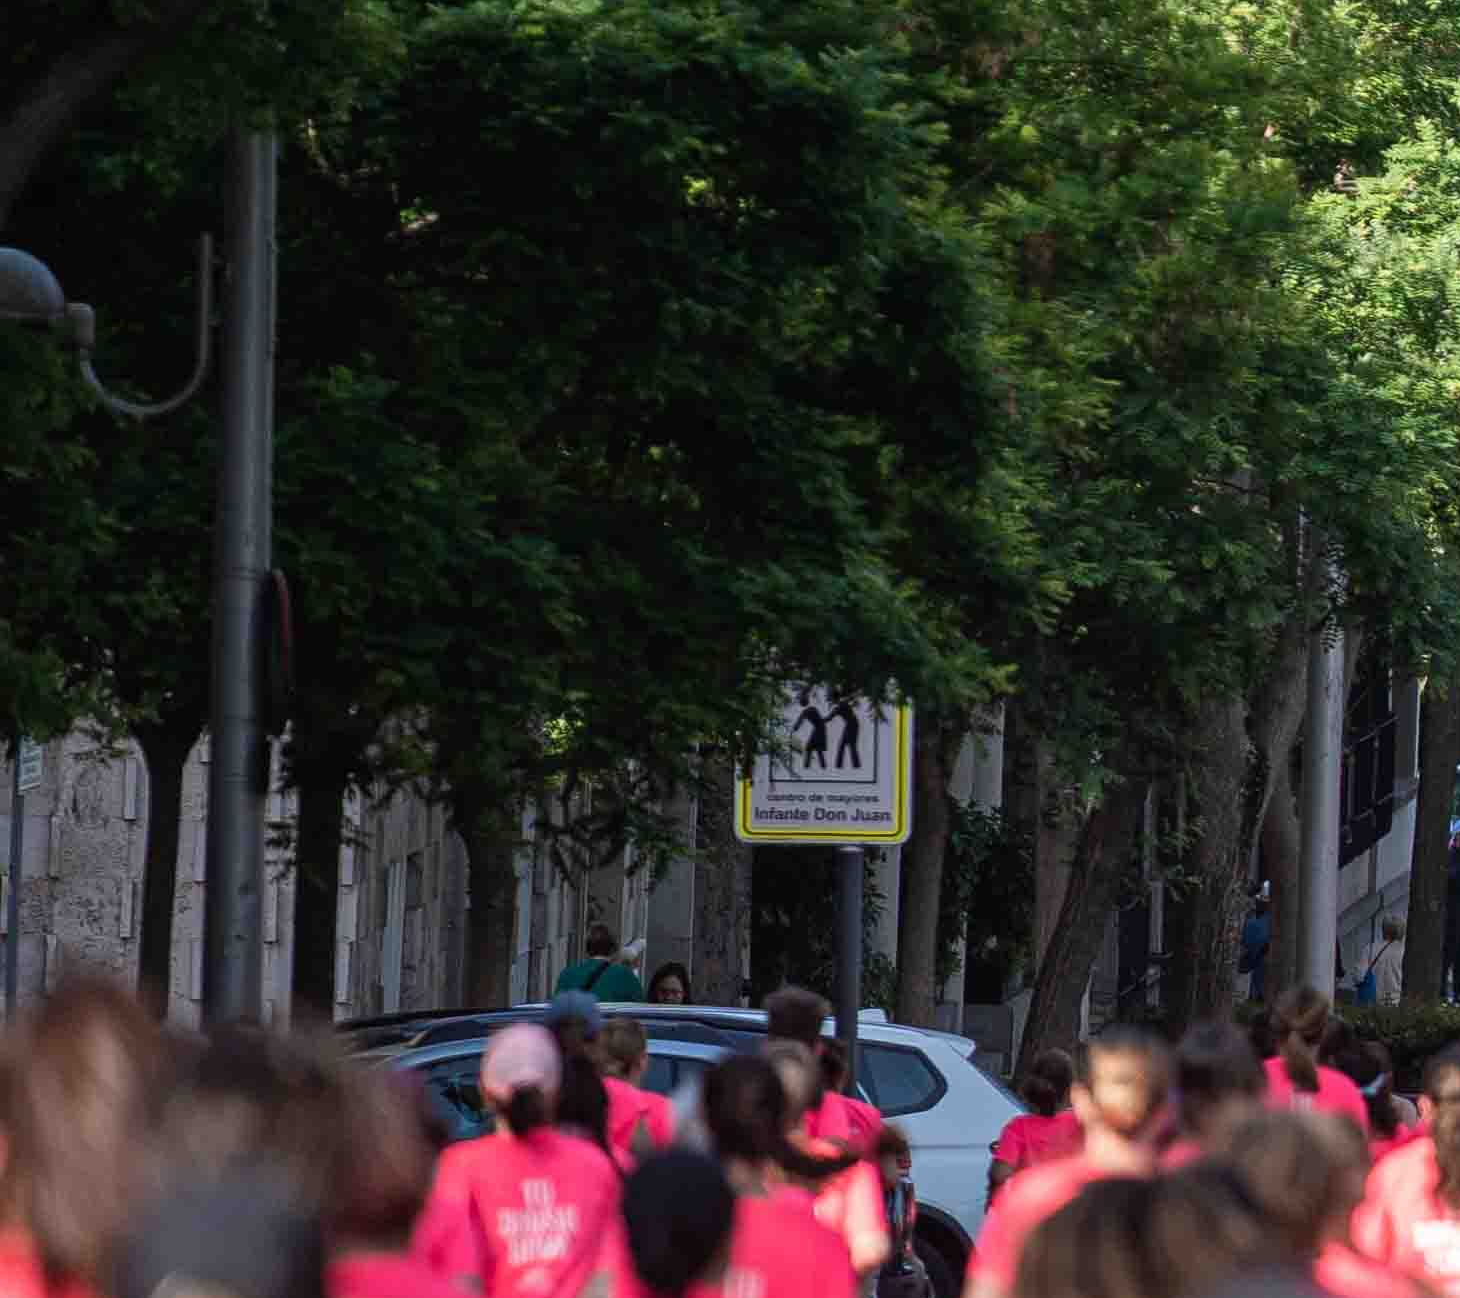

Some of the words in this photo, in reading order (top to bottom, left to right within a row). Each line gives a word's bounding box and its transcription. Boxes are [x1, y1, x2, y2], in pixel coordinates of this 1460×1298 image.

[754, 806, 809, 821] Infante
[814, 807, 847, 821] Don
[850, 808, 892, 822] Juan
